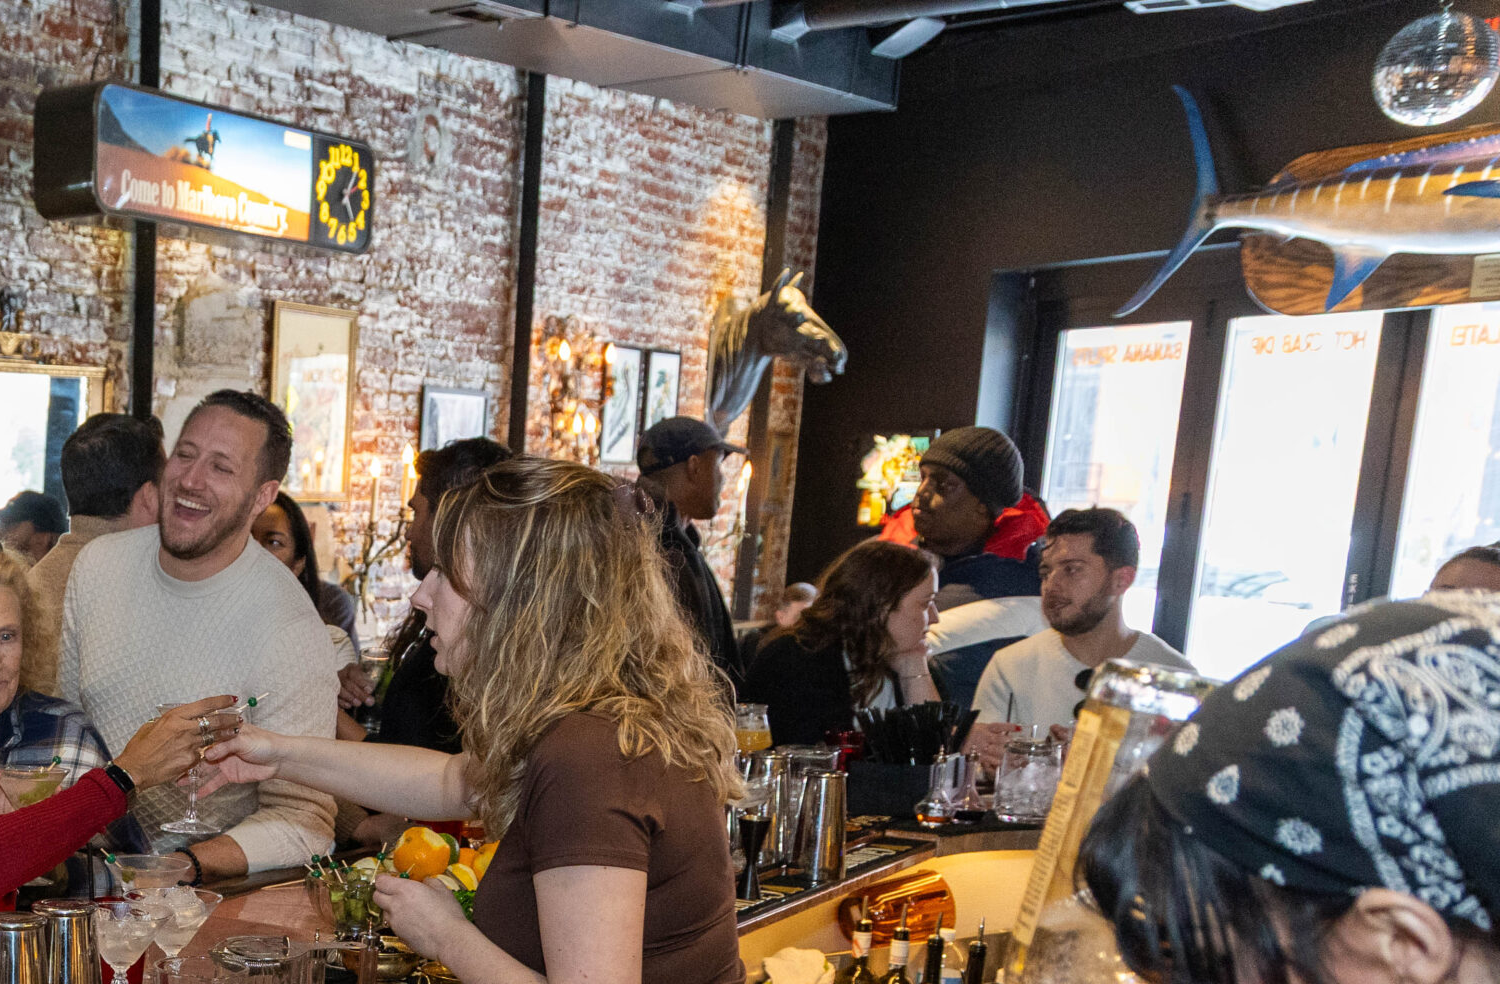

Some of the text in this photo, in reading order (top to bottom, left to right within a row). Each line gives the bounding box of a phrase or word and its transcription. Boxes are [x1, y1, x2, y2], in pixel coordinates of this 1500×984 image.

[328, 146, 341, 169] 11
[340, 144, 353, 167] 12
[319, 160, 336, 184] 10
[358, 168, 367, 190] 2
[121, 169, 160, 207] Come
[162, 179, 175, 209] to
[177, 180, 237, 221] Marlboro
[315, 178, 327, 201] 9
[361, 189, 370, 210] 3
[319, 201, 330, 223] 8
[356, 209, 365, 230] 4
[328, 217, 338, 239] 7
[337, 224, 346, 245] 6
[347, 222, 357, 243] 5
